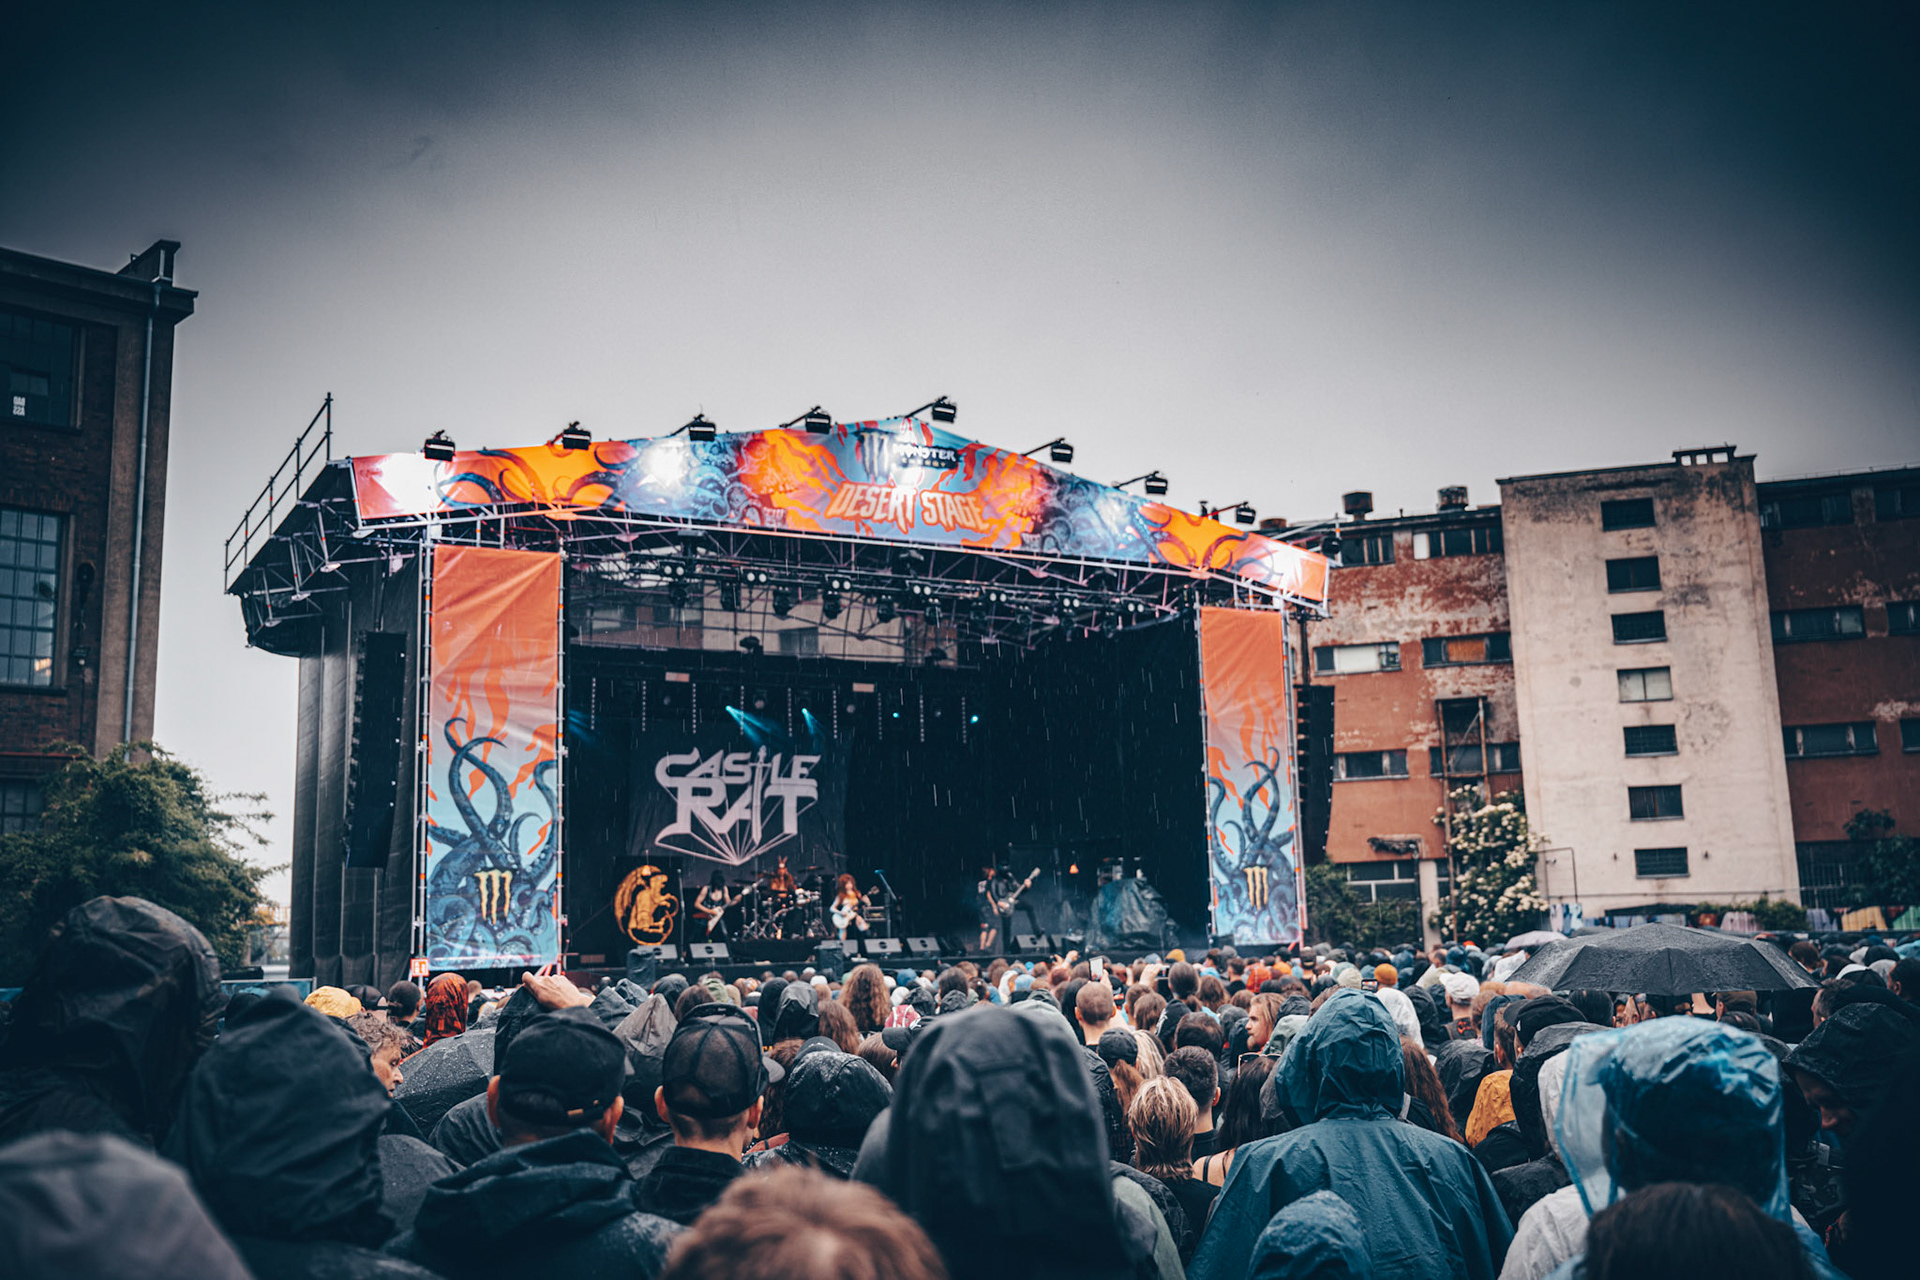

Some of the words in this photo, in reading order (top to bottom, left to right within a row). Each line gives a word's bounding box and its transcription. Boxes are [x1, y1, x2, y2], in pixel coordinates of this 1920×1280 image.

[893, 443, 957, 462] MONSTER
[827, 482, 917, 533] DESERT
[922, 491, 990, 532] STAGE
[655, 746, 821, 788] CASTLE
[655, 777, 818, 845] RAT
